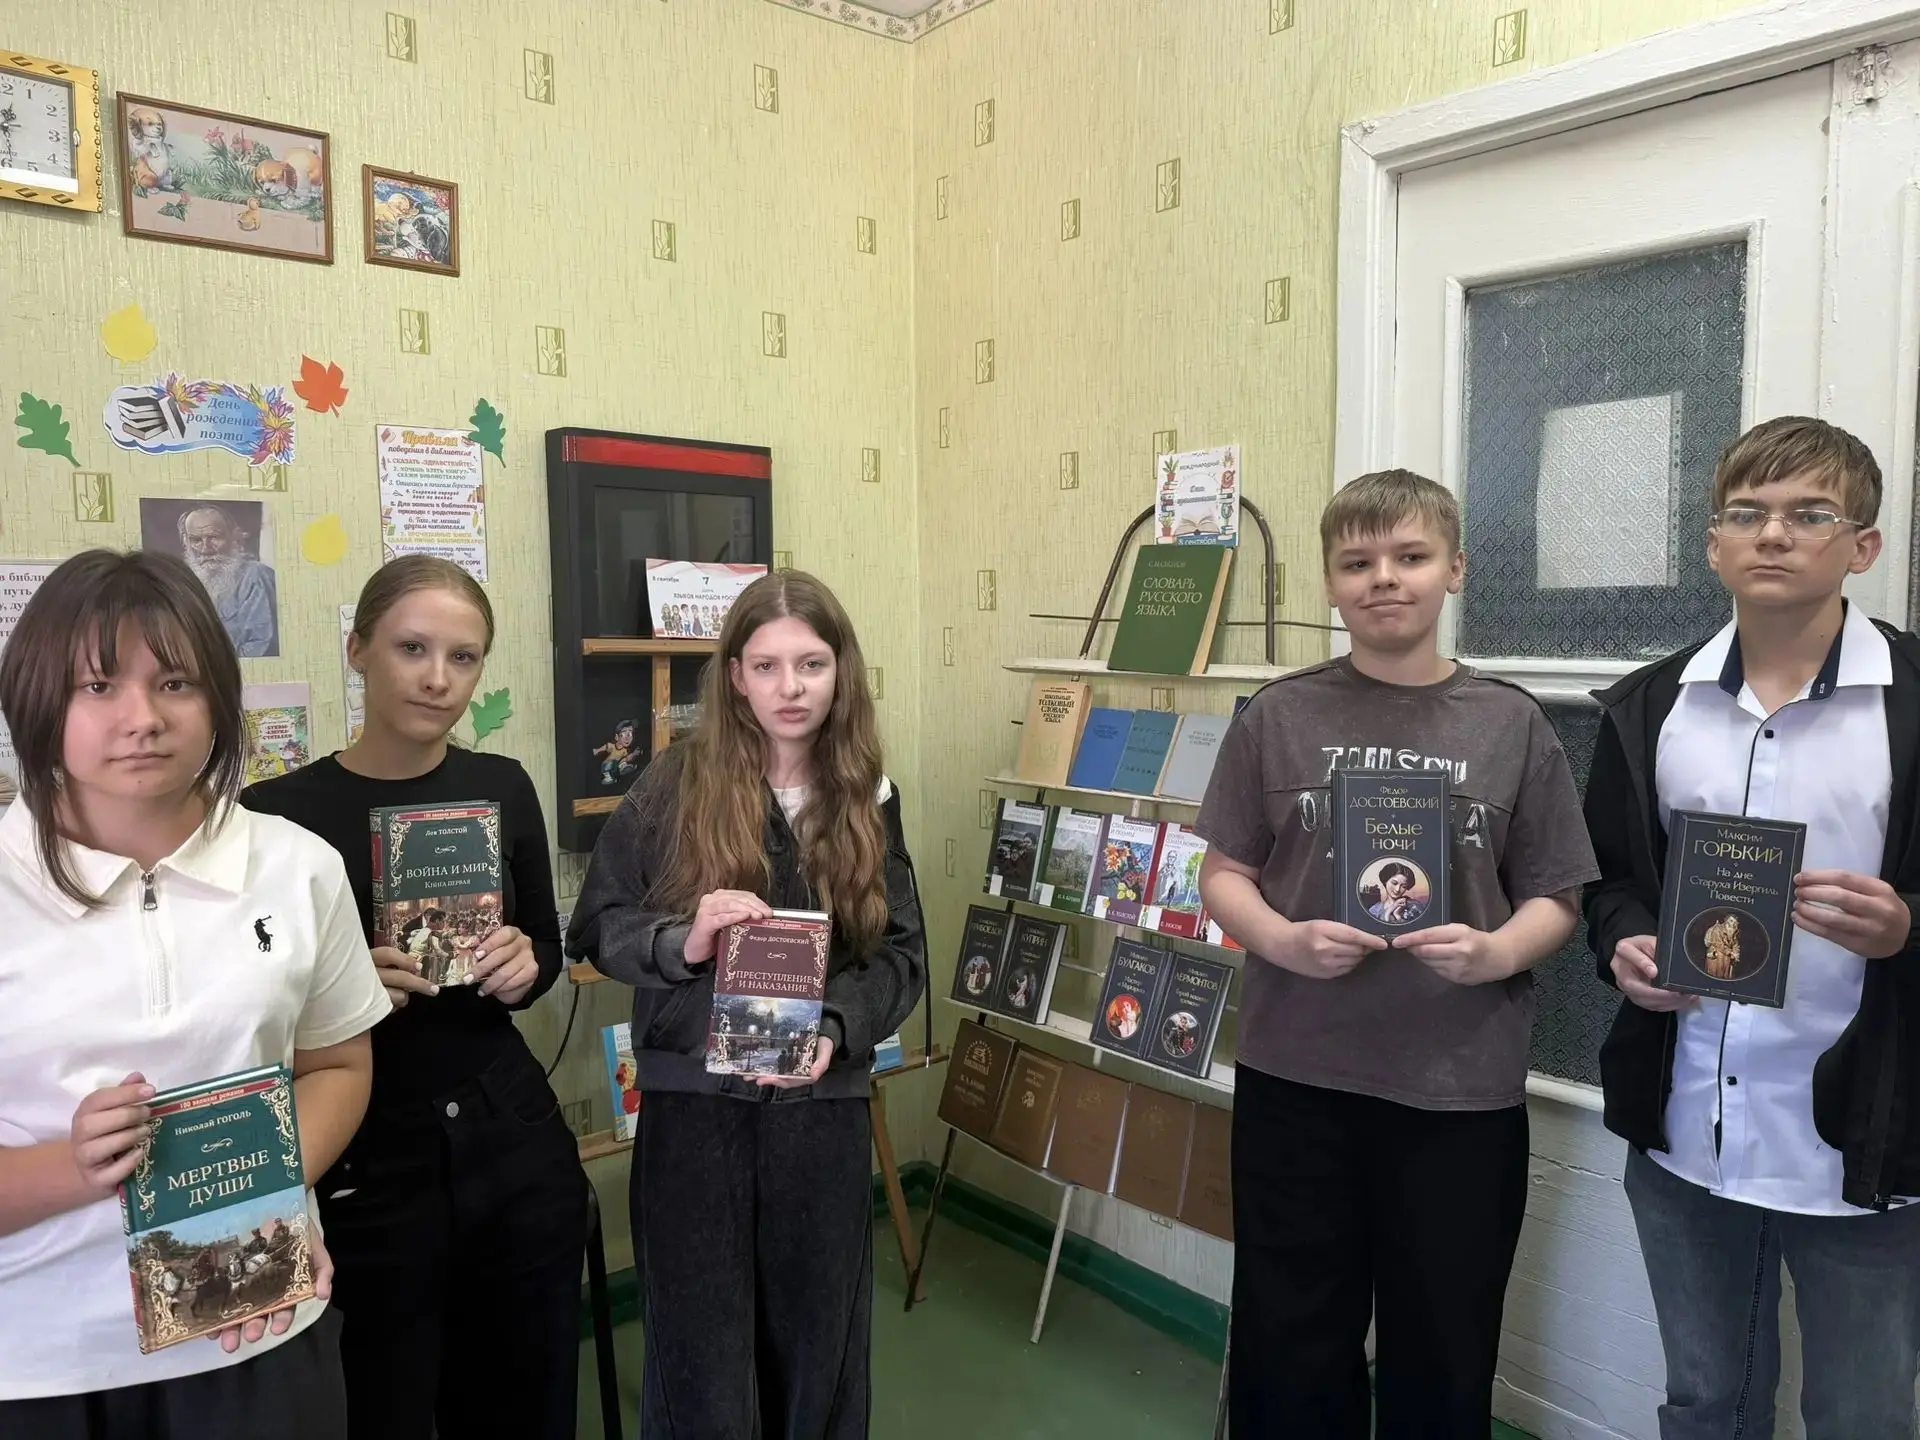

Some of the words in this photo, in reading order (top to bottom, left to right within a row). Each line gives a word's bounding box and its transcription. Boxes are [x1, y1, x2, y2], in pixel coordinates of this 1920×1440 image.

[27, 89, 33, 100] 1
[46, 105, 57, 118] 2
[48, 130, 60, 143] 3
[47, 153, 58, 165] 4
[207, 397, 241, 410] День
[200, 430, 244, 441] поэта
[9, 572, 47, 582] библи
[702, 576, 710, 585] 7
[1143, 577, 1196, 589] СЛОВАРЬ
[4, 588, 32, 598] путь
[1139, 591, 1203, 604] РУССКОГО
[1135, 604, 1177, 616] ЯЗЫКА
[1040, 706, 1070, 714] СЛОВАРЬ
[1349, 796, 1440, 809] ДОСТОЕВСКИЙ
[439, 826, 468, 836] ТОЛСТОЙ
[1364, 817, 1424, 836] Белые
[1694, 840, 1783, 865] ГОРЬКИЙ
[406, 864, 448, 878] ВОЙНА
[451, 865, 460, 874] И
[462, 862, 488, 873] МИР
[1716, 866, 1731, 878] На
[1733, 871, 1754, 880] дне
[1689, 875, 1731, 890] Старуха
[1733, 881, 1779, 896] Изергиль
[1710, 889, 1755, 905] Повести
[768, 936, 810, 945] ДОСТОЕВСКИЙ
[1118, 956, 1156, 976] БУЛГАКОВ
[736, 970, 814, 984] ПРЕСТУПЛЕНИЕ
[1174, 972, 1218, 991] ЛЕРМОНТОВ
[738, 980, 746, 988] И
[748, 981, 808, 993] НАКАЗАНИЕ
[180, 1101, 191, 1109] 100
[219, 1089, 245, 1101] романов
[174, 1117, 216, 1136] Николай
[216, 1110, 252, 1125] ГОГОЛЬ
[167, 1149, 271, 1191] МЕРТВЫЕ
[188, 1173, 255, 1208] ДУШИ
